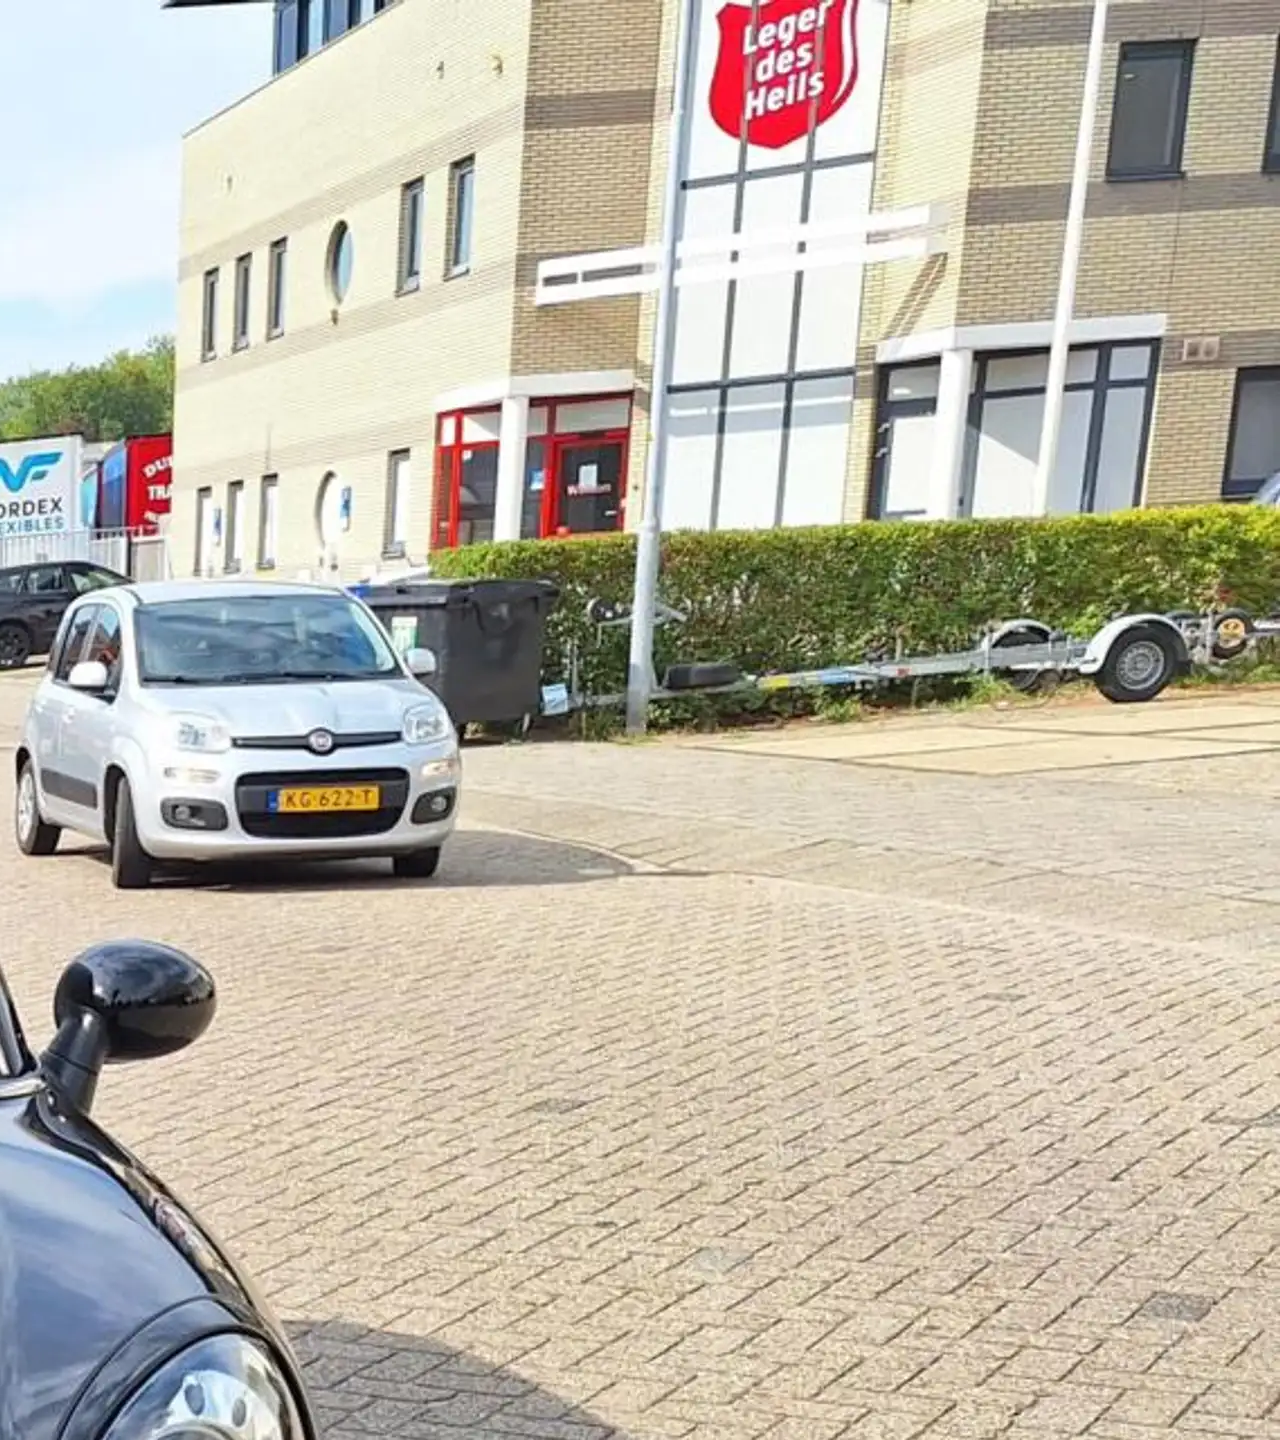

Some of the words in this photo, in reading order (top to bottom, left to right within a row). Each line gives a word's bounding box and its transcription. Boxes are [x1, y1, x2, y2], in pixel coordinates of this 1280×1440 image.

[742, 0, 833, 56] Leger
[755, 42, 814, 83] des
[744, 71, 825, 121] Heils
